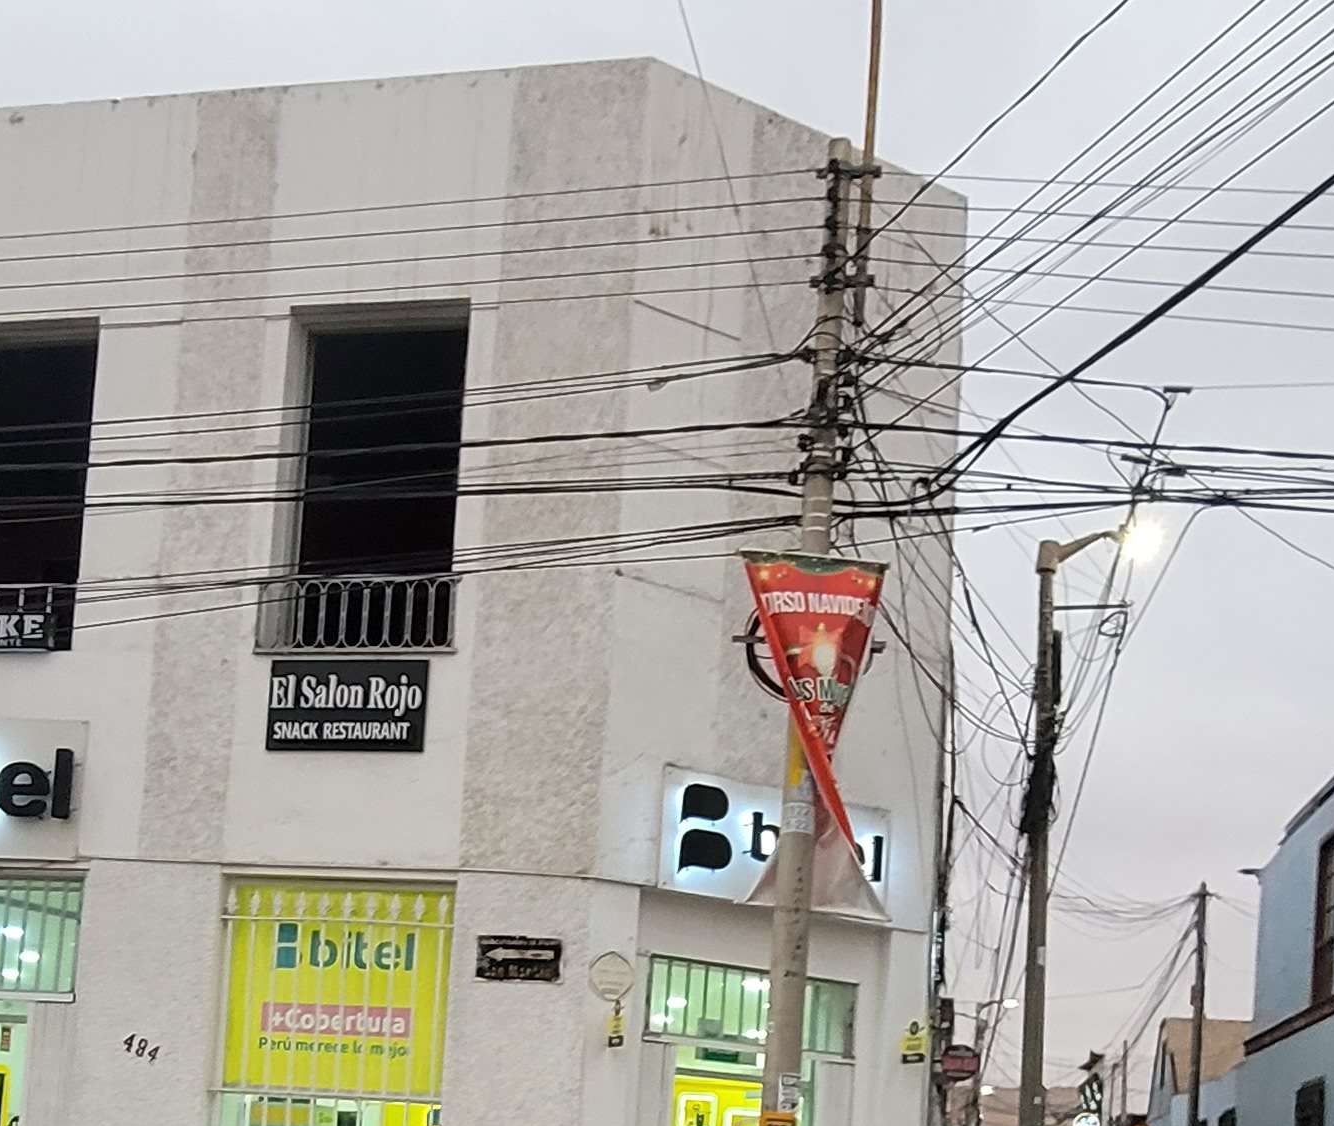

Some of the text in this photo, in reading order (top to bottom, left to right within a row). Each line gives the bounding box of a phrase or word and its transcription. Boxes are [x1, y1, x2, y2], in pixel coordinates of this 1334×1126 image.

[270, 674, 422, 717] El Salon Rojo
[273, 721, 410, 741] SNACK RESTAURANT
[309, 930, 416, 972] bitel
[123, 1033, 160, 1064] 484
